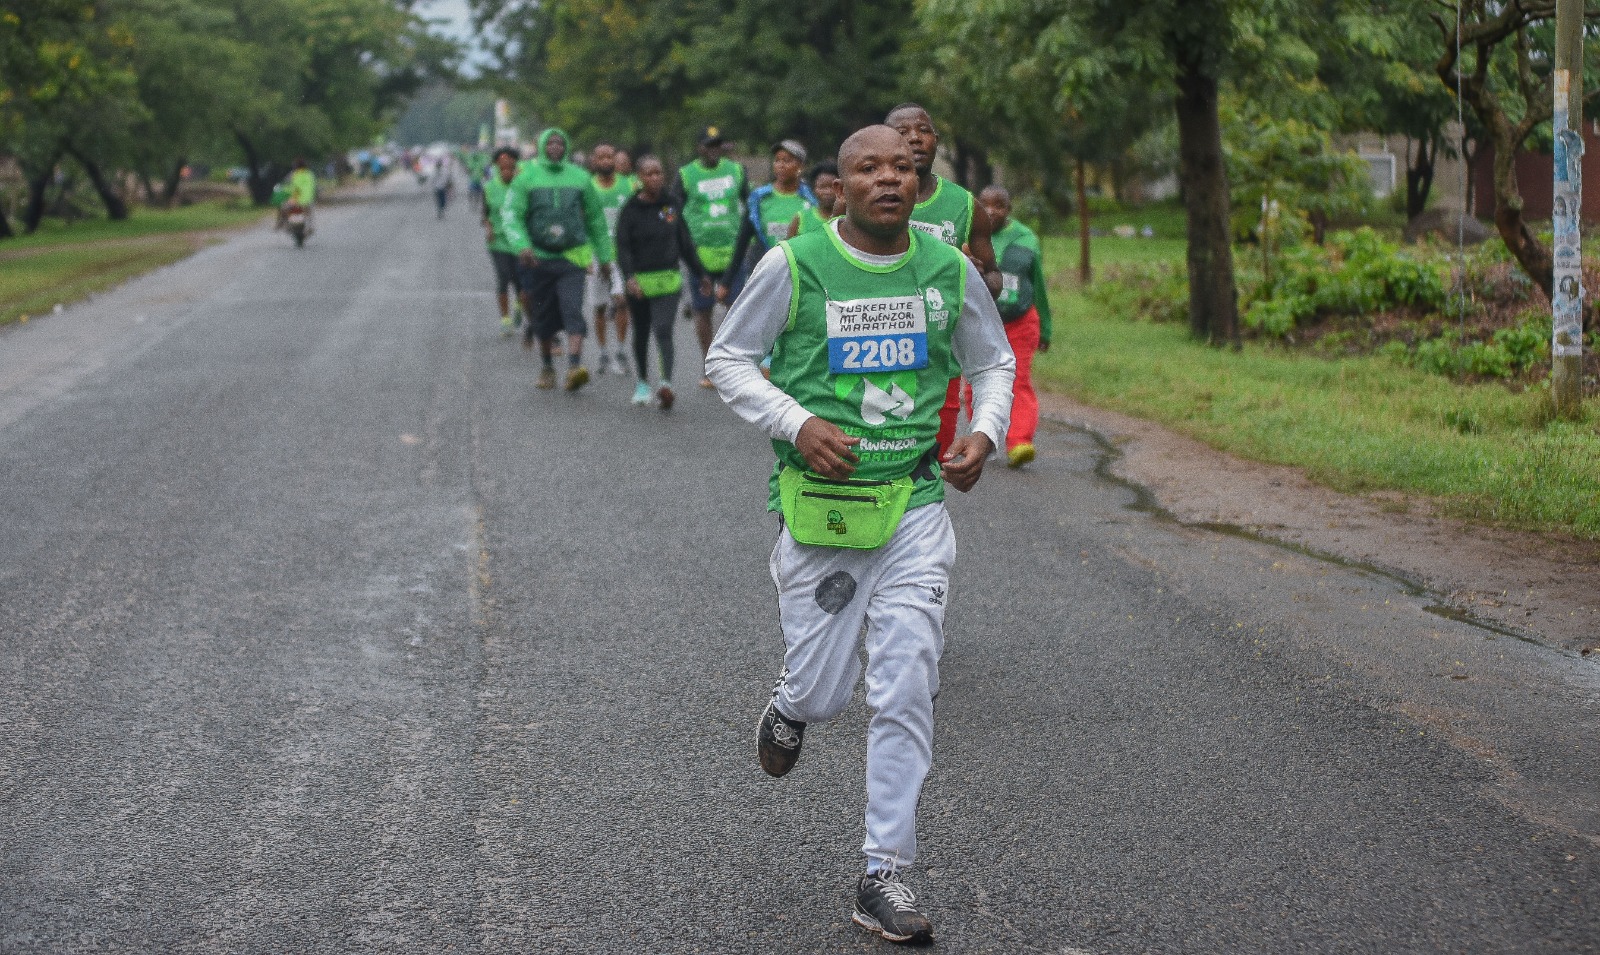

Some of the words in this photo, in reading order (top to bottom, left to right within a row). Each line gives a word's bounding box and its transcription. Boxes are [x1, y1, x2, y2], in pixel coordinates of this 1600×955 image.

[839, 303, 887, 314] TUSKER
[889, 301, 914, 311] LITE
[840, 314, 857, 324] MT
[840, 321, 915, 332] MARATHON
[842, 338, 916, 369] 2208
